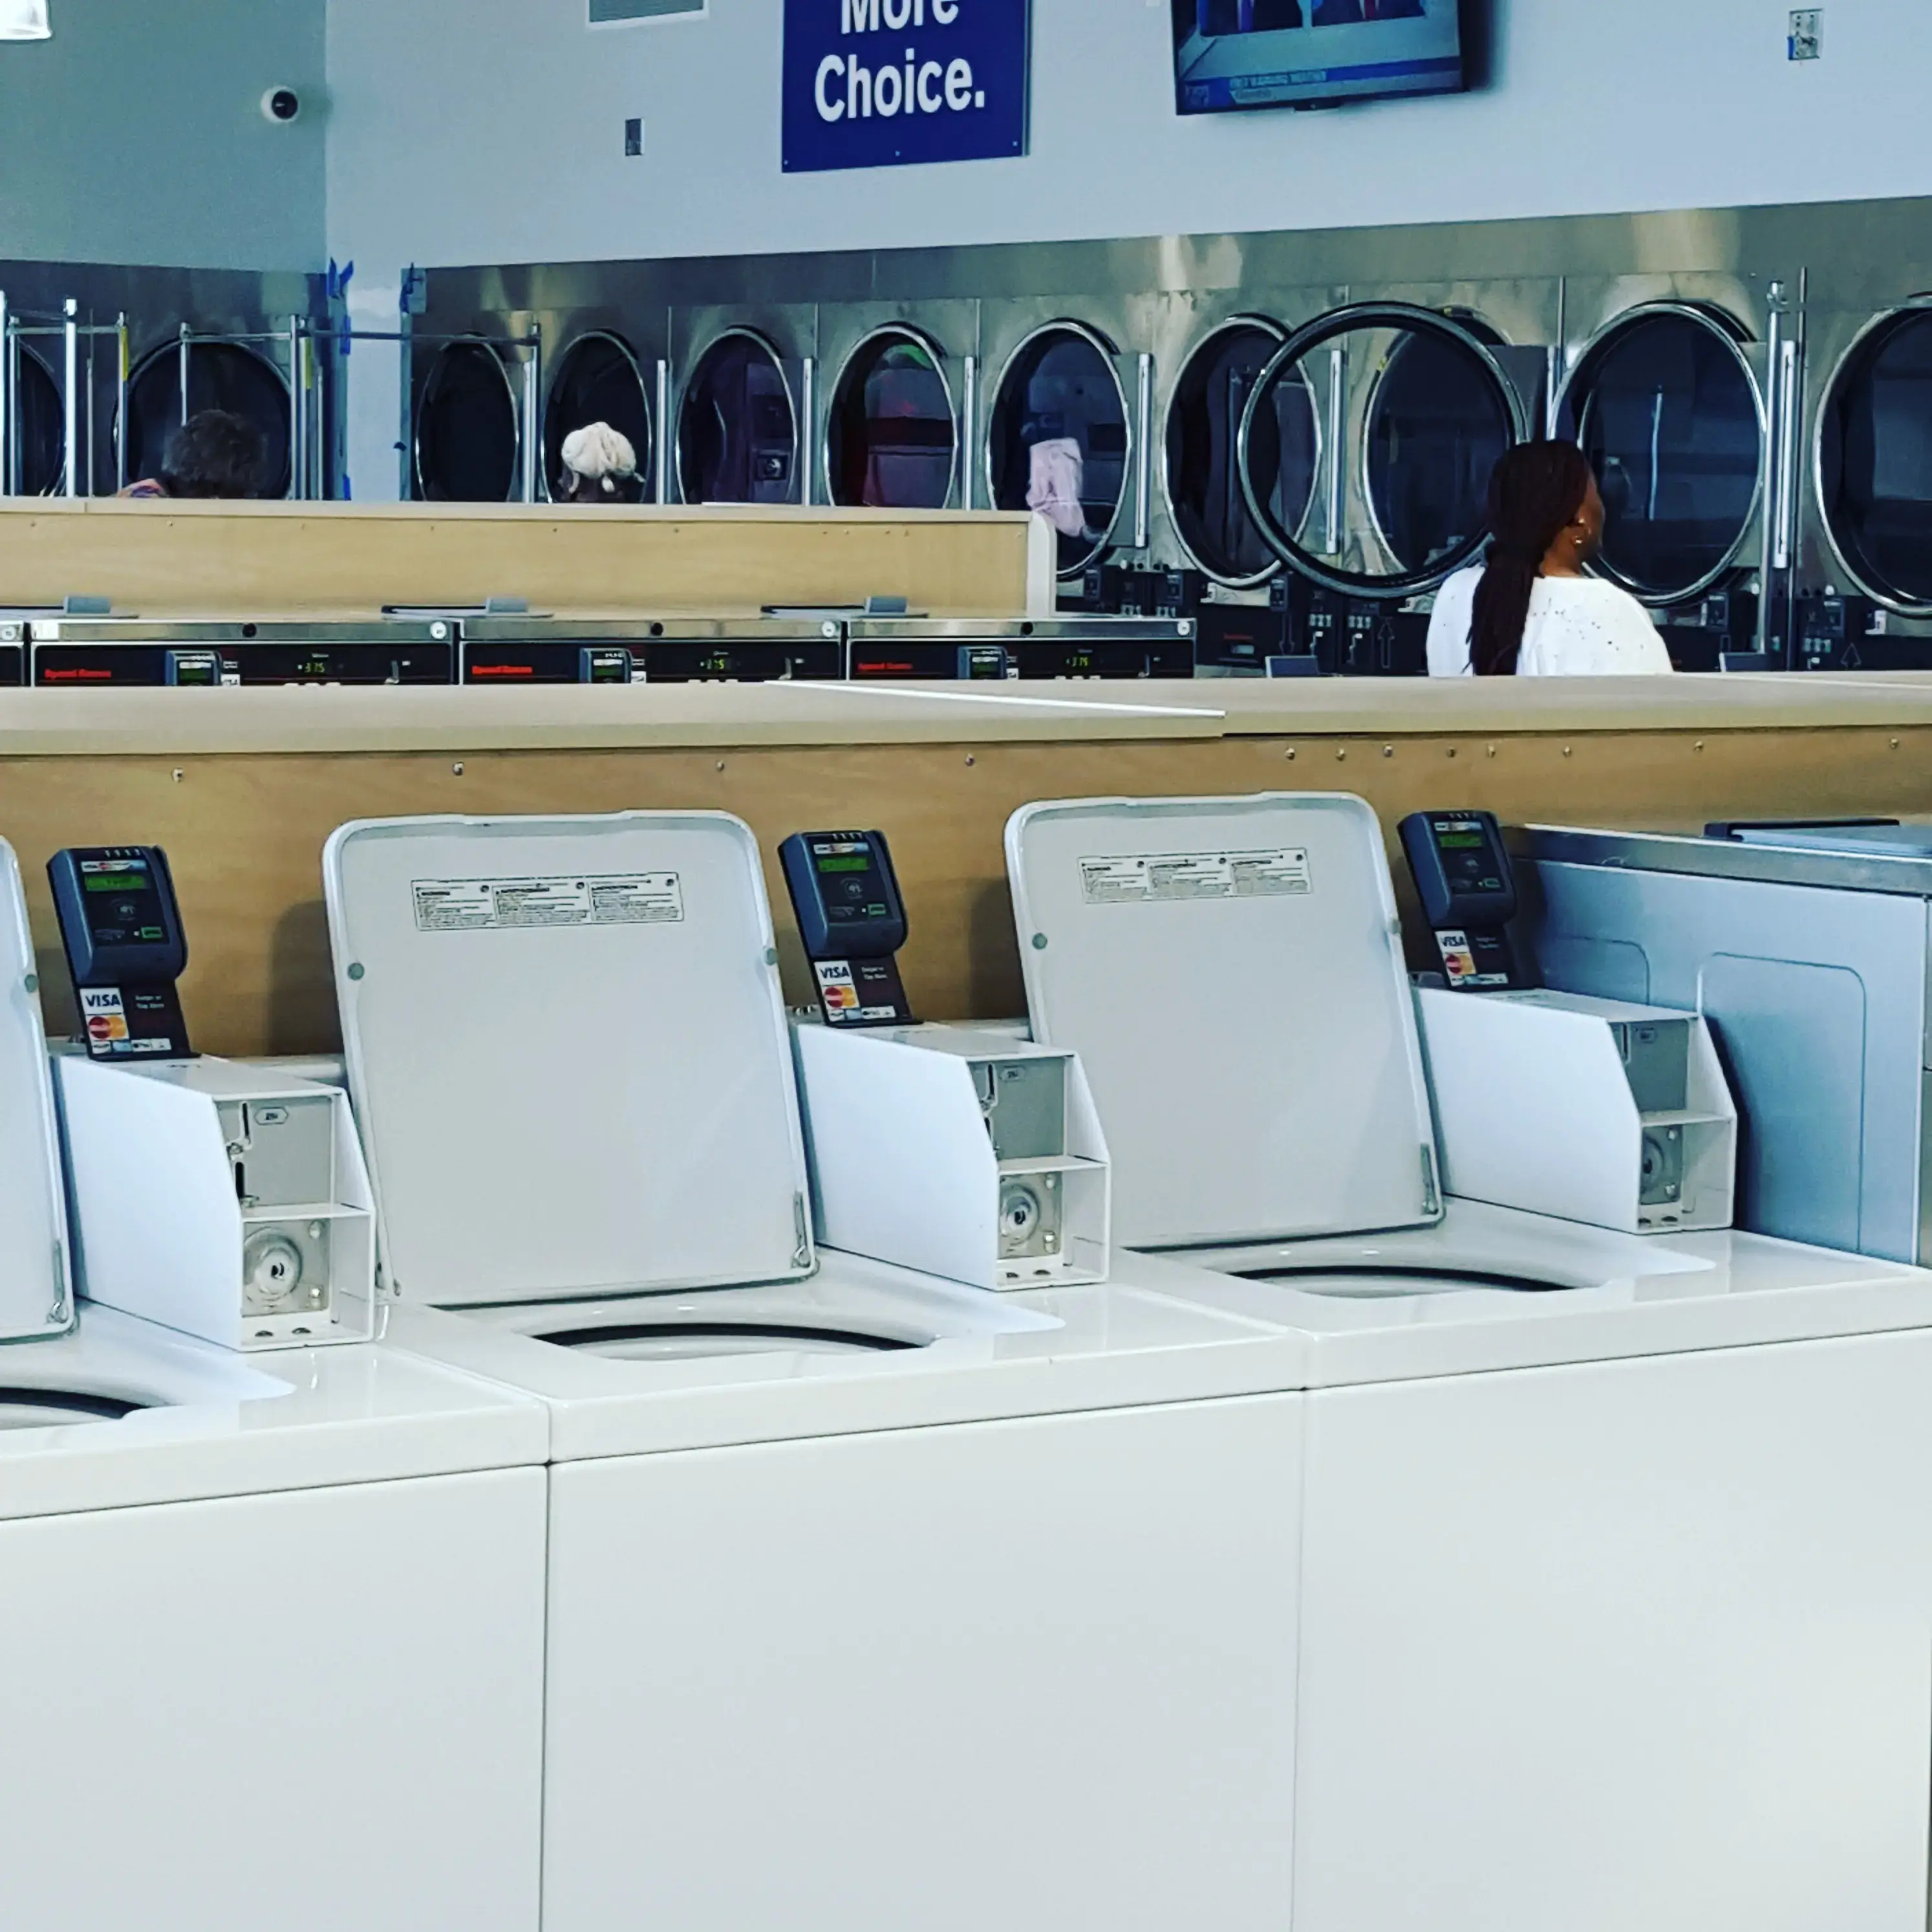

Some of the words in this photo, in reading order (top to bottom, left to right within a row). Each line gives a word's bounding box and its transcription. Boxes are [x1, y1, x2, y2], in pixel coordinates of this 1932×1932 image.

[815, 48, 985, 122] Choice.
[1443, 936, 1466, 947] VISA
[820, 967, 850, 978] VISA
[85, 994, 120, 1007] VISA
